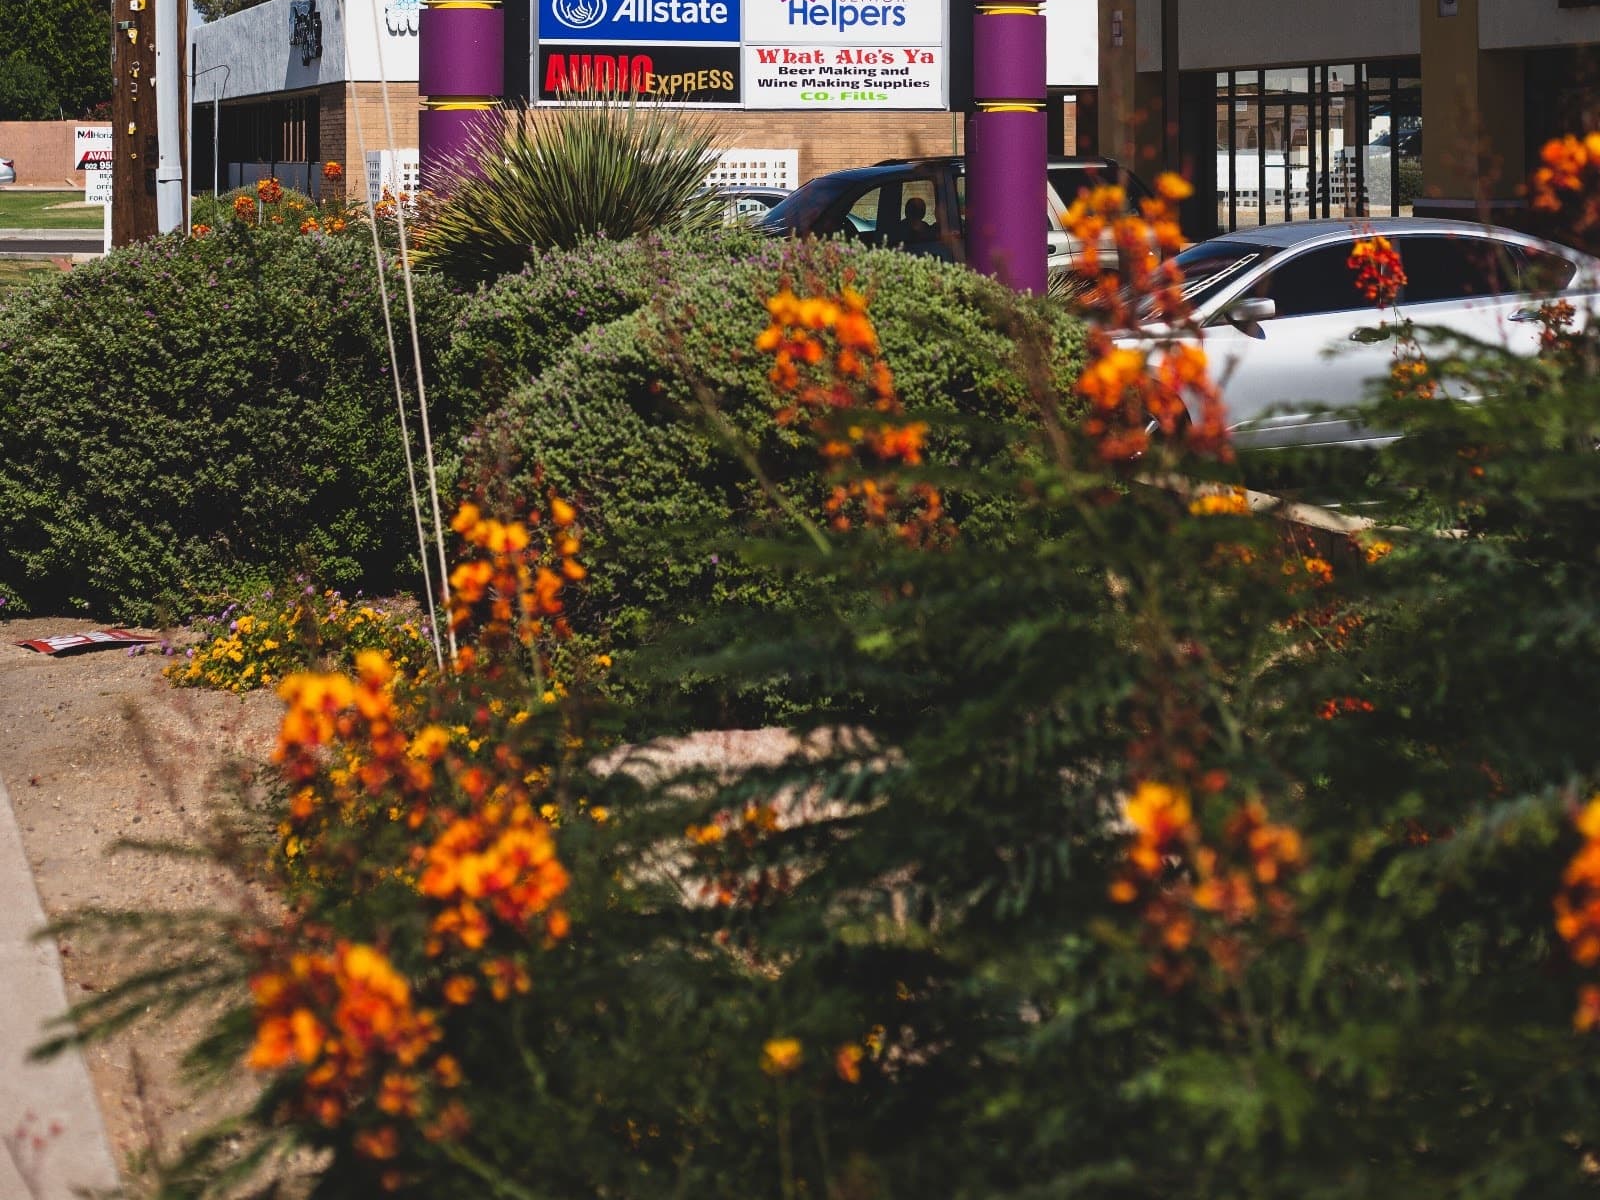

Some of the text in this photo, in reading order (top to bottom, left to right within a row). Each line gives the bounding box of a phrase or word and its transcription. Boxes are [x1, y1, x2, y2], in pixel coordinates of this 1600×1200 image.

[756, 49, 935, 64] What Ale's Ya
[544, 54, 734, 95] AUDIO EXPRESS
[778, 66, 909, 77] Beer Making and
[757, 79, 930, 89] Wine Making Supplies
[840, 91, 888, 101] Fills
